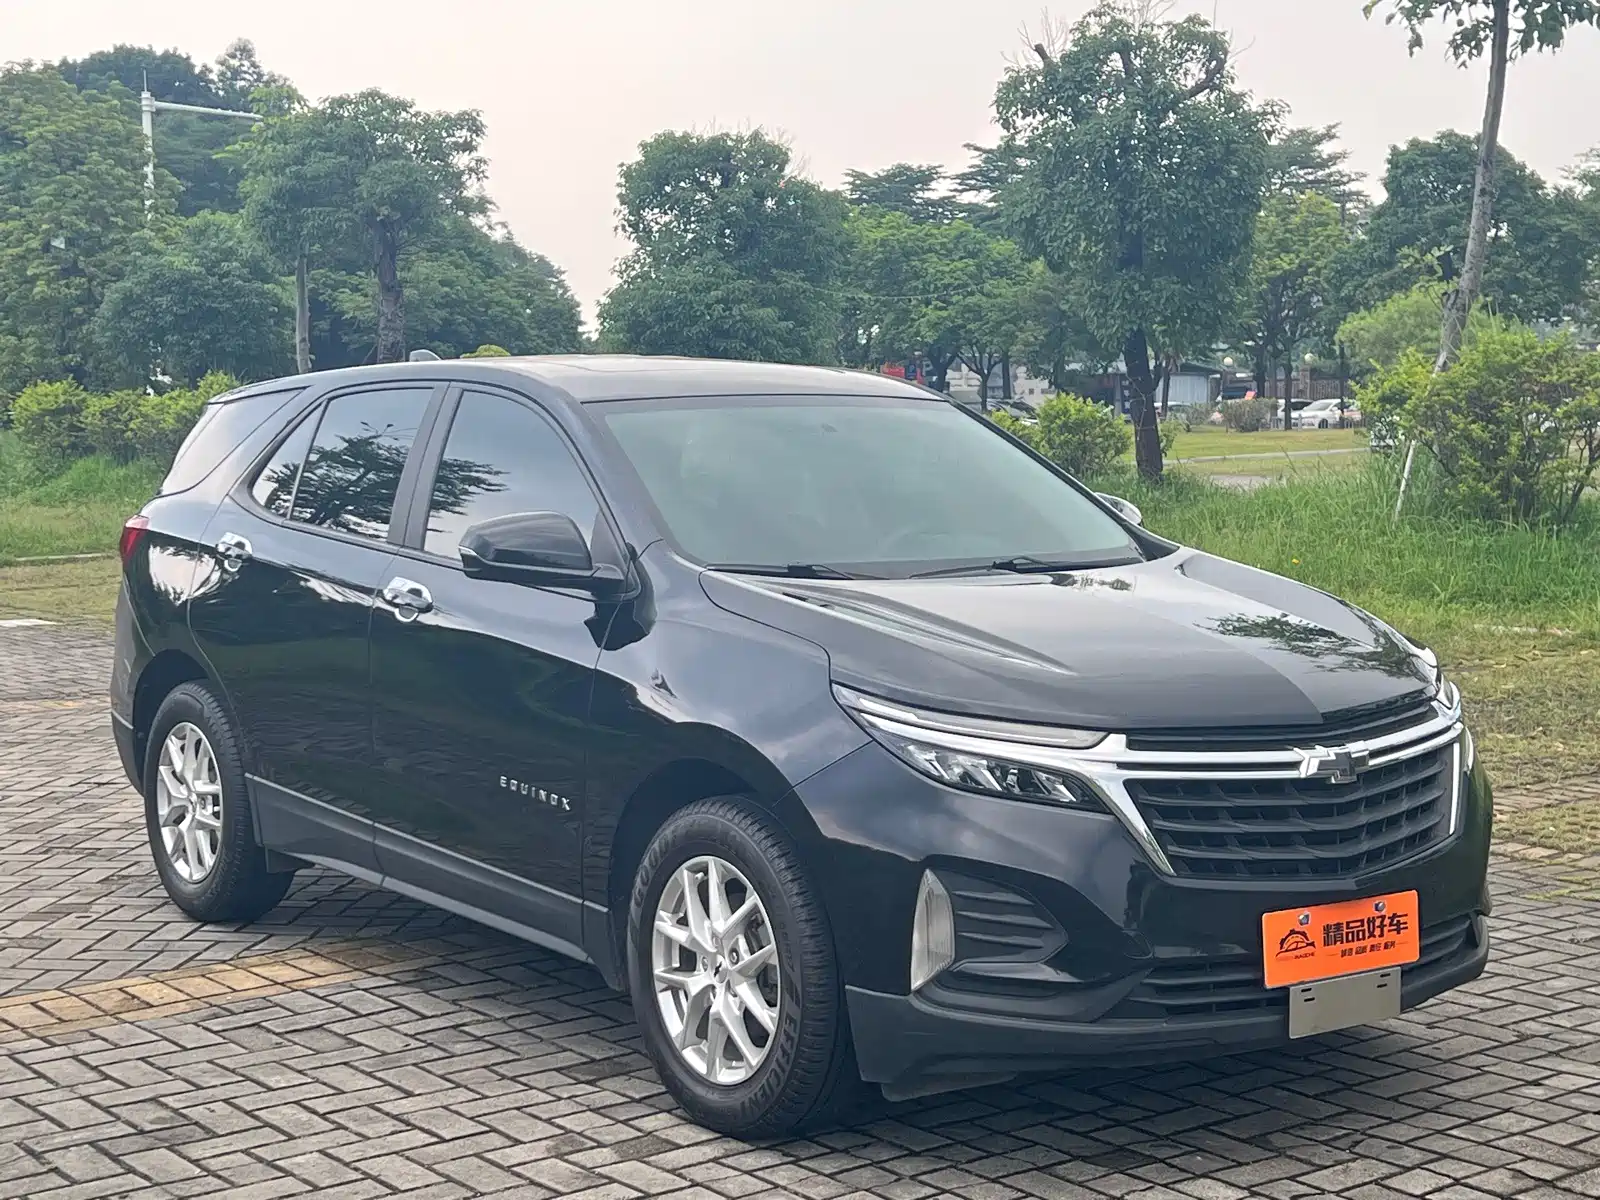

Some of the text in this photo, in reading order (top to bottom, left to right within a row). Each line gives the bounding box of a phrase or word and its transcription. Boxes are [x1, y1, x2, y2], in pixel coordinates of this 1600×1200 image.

[500, 775, 571, 811] EQUINOX
[1323, 913, 1409, 947] 精品好车
